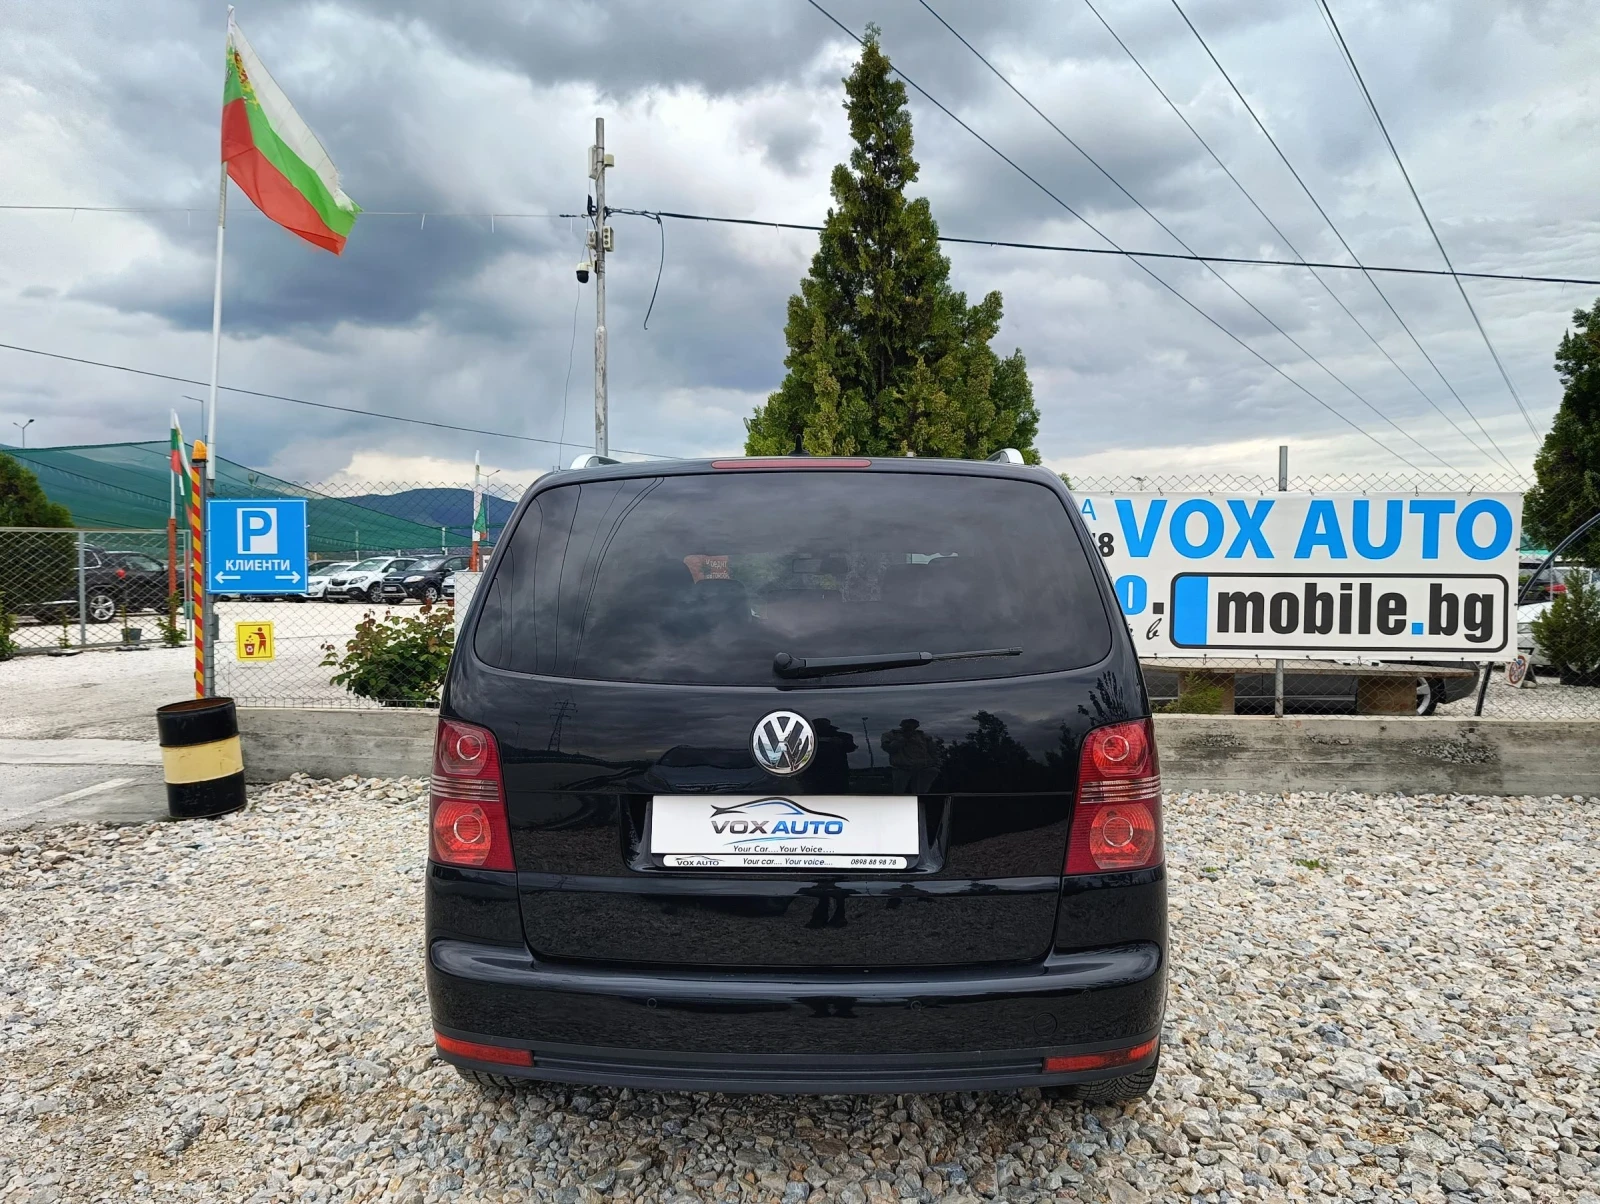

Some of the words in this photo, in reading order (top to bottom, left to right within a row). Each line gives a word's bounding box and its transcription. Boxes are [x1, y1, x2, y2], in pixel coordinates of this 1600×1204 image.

[1114, 499, 1276, 560] VOX
[1293, 499, 1513, 561] AUTO
[226, 559, 292, 571] КЛИЕНТИ
[1216, 582, 1495, 644] mobile.bg
[711, 821, 769, 835] VOX
[770, 821, 846, 835] AUTO
[733, 845, 752, 853] Your
[743, 857, 760, 865] Your
[785, 857, 802, 865] Your
[850, 858, 868, 866] 0898
[868, 858, 878, 866] 88
[879, 858, 887, 866] 98
[888, 858, 897, 866] 78
